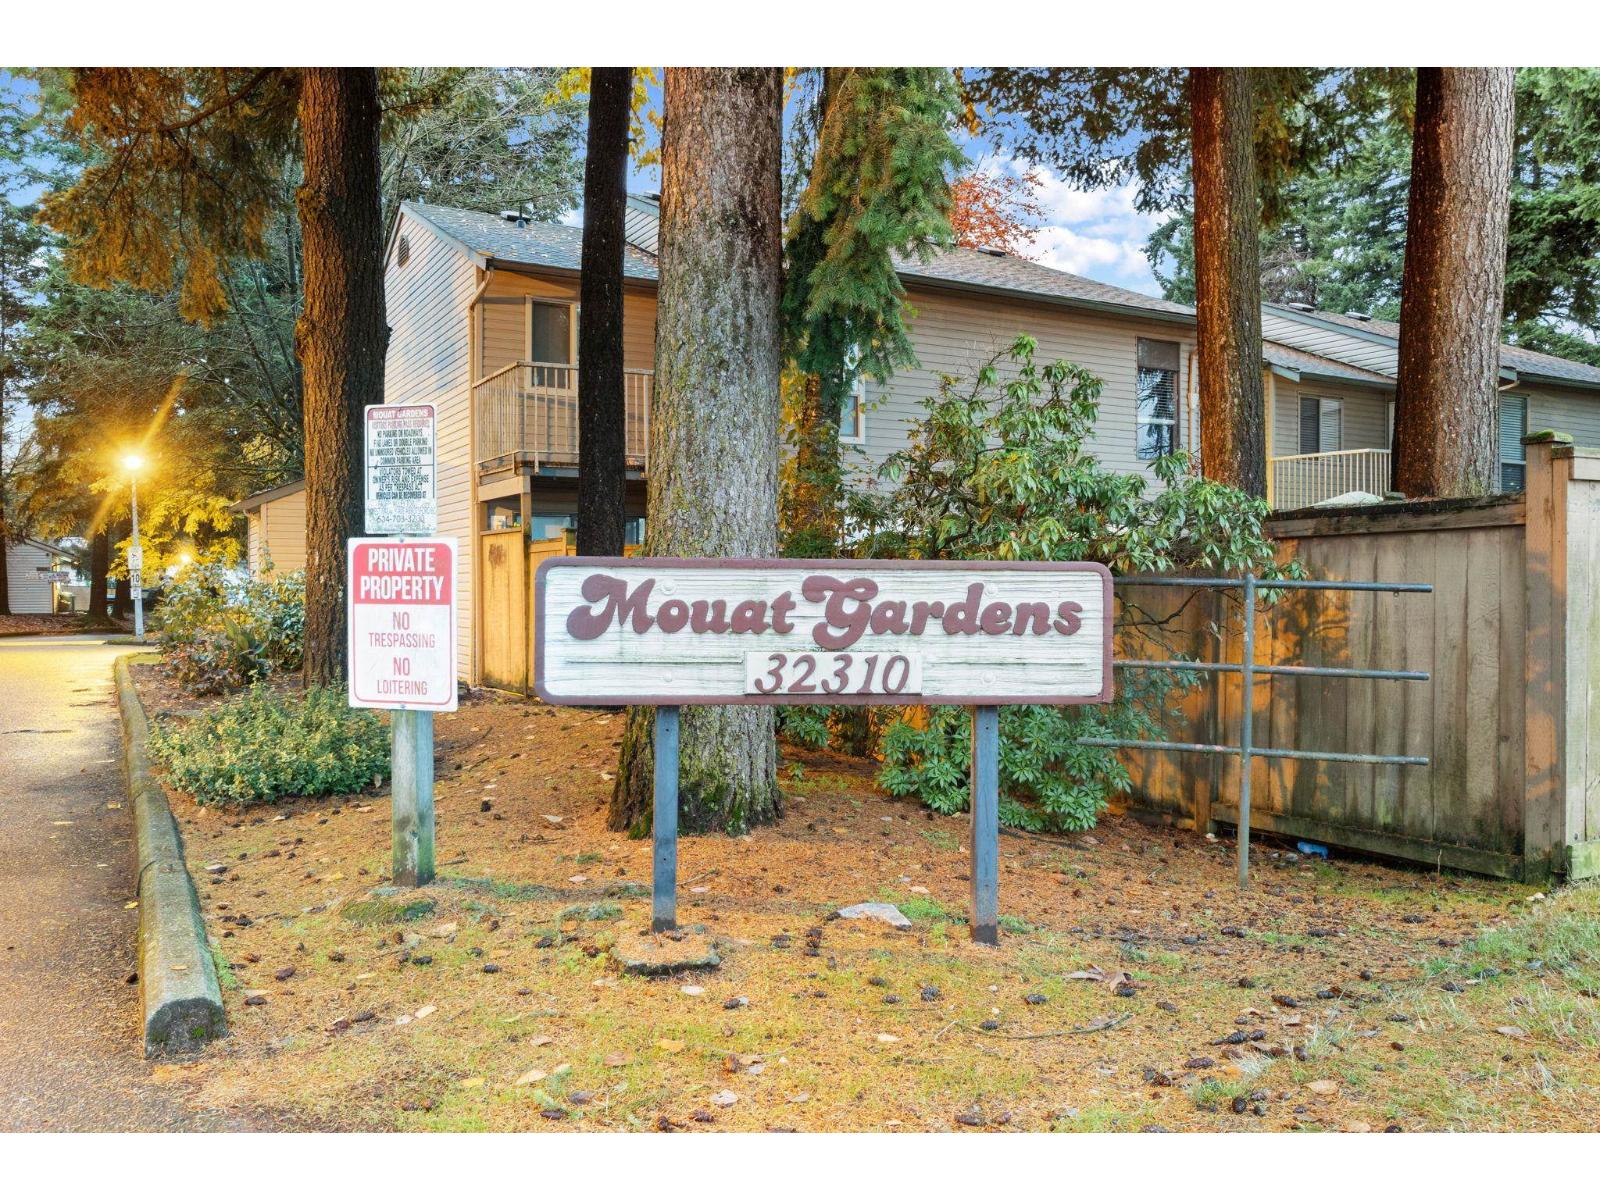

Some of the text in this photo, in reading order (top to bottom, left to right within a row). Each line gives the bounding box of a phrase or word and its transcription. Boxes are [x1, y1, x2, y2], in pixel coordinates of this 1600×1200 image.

[397, 409, 429, 418] GARDENS
[383, 429, 398, 438] PARKING
[398, 437, 412, 446] DOUBLE
[412, 437, 428, 446] PARKING
[396, 456, 411, 465] PARKING
[379, 466, 423, 476] VIOLATORS TOWED AT
[391, 475, 401, 483] RISK
[401, 474, 411, 483] AND
[411, 474, 429, 483] EXPENSE
[385, 483, 393, 491] PER
[394, 483, 414, 491] TRESPASS
[414, 482, 423, 491] ACT
[368, 547, 436, 572] PRIVATE
[131, 573, 140, 583] 10
[360, 575, 445, 600] PROPERTY
[566, 572, 1083, 651] Mouat Gardens
[392, 611, 410, 631] NO
[368, 632, 436, 648] TRESPASSING
[393, 657, 410, 676] NO
[754, 652, 911, 695] 32310
[377, 679, 428, 696] LOITERING
